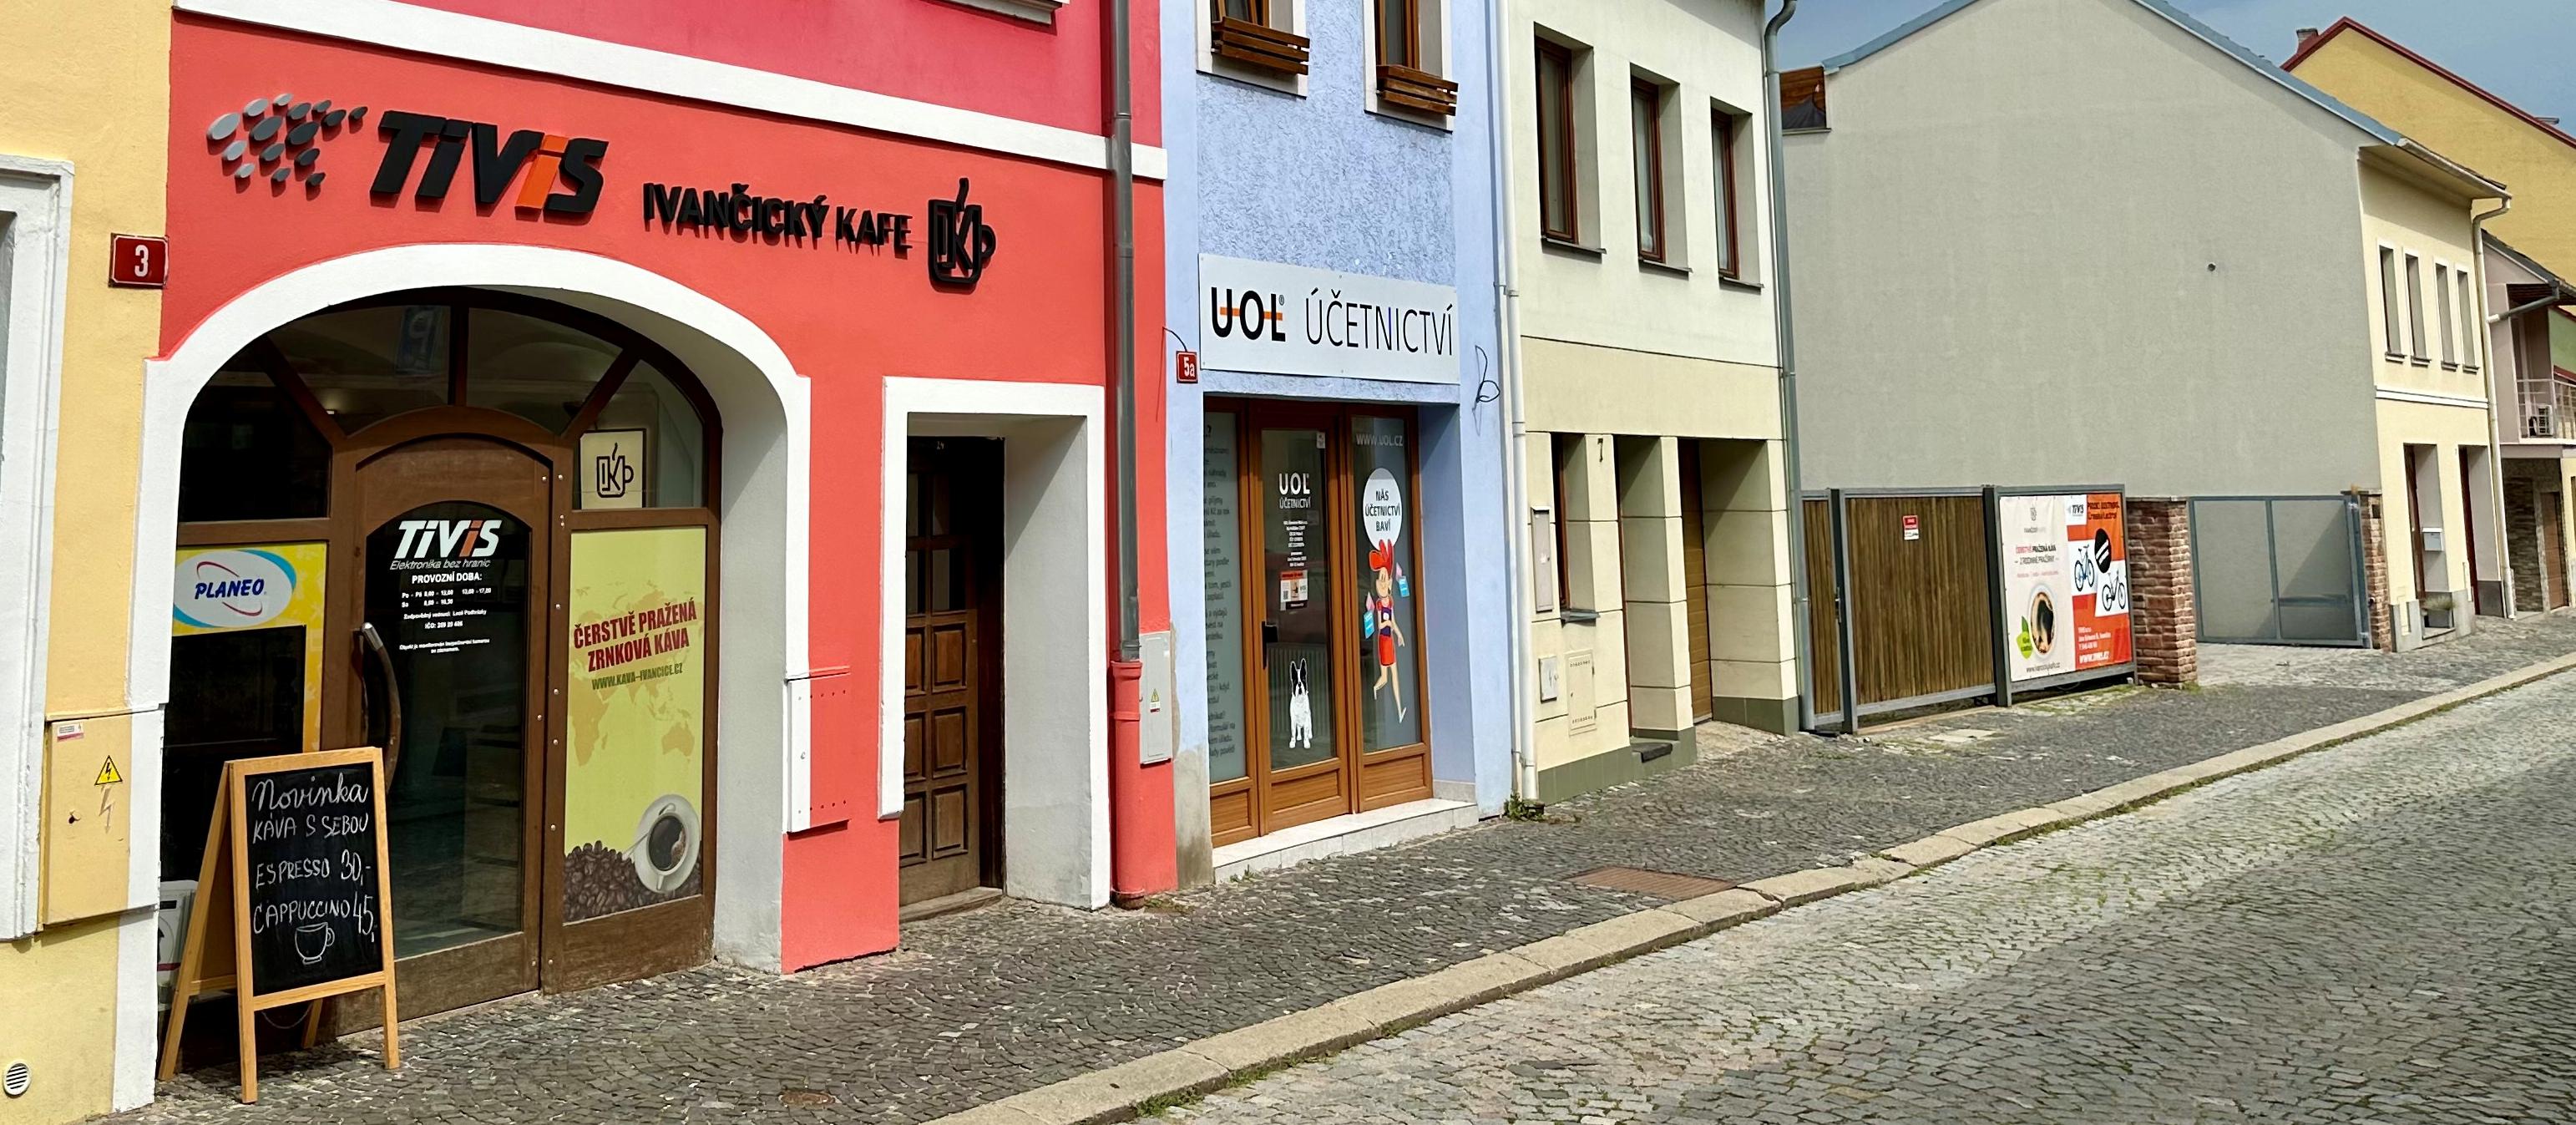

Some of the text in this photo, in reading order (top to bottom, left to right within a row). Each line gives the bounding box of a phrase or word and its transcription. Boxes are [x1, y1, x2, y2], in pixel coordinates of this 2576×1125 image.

[643, 182, 913, 252] IVANČICKÝ KAFE
[134, 245, 149, 277] 3
[1305, 287, 1454, 356] ÚČETNICTVÍ
[1183, 356, 1196, 378] 5a
[1364, 503, 1401, 516] ÚČETNICTVÍ
[1375, 519, 1391, 532] BAVÍ
[390, 558, 491, 570] Elektronika bez hranic
[412, 571, 483, 585] PROVOZNÍ DOBA:
[194, 578, 266, 601] PLANEO
[574, 596, 698, 650] ČERSTVĚ PRAŽENÁ
[587, 627, 691, 673] ZRNKOVÁ KÁVA
[591, 661, 684, 691] WWW.KAVA-IVANCICE.CZ
[251, 772, 369, 812] Novinka
[252, 811, 297, 844] KÁVA
[321, 812, 369, 839] SEBOU
[256, 858, 331, 890] ESPRESSO
[253, 899, 351, 935] CAPPUCCINO
